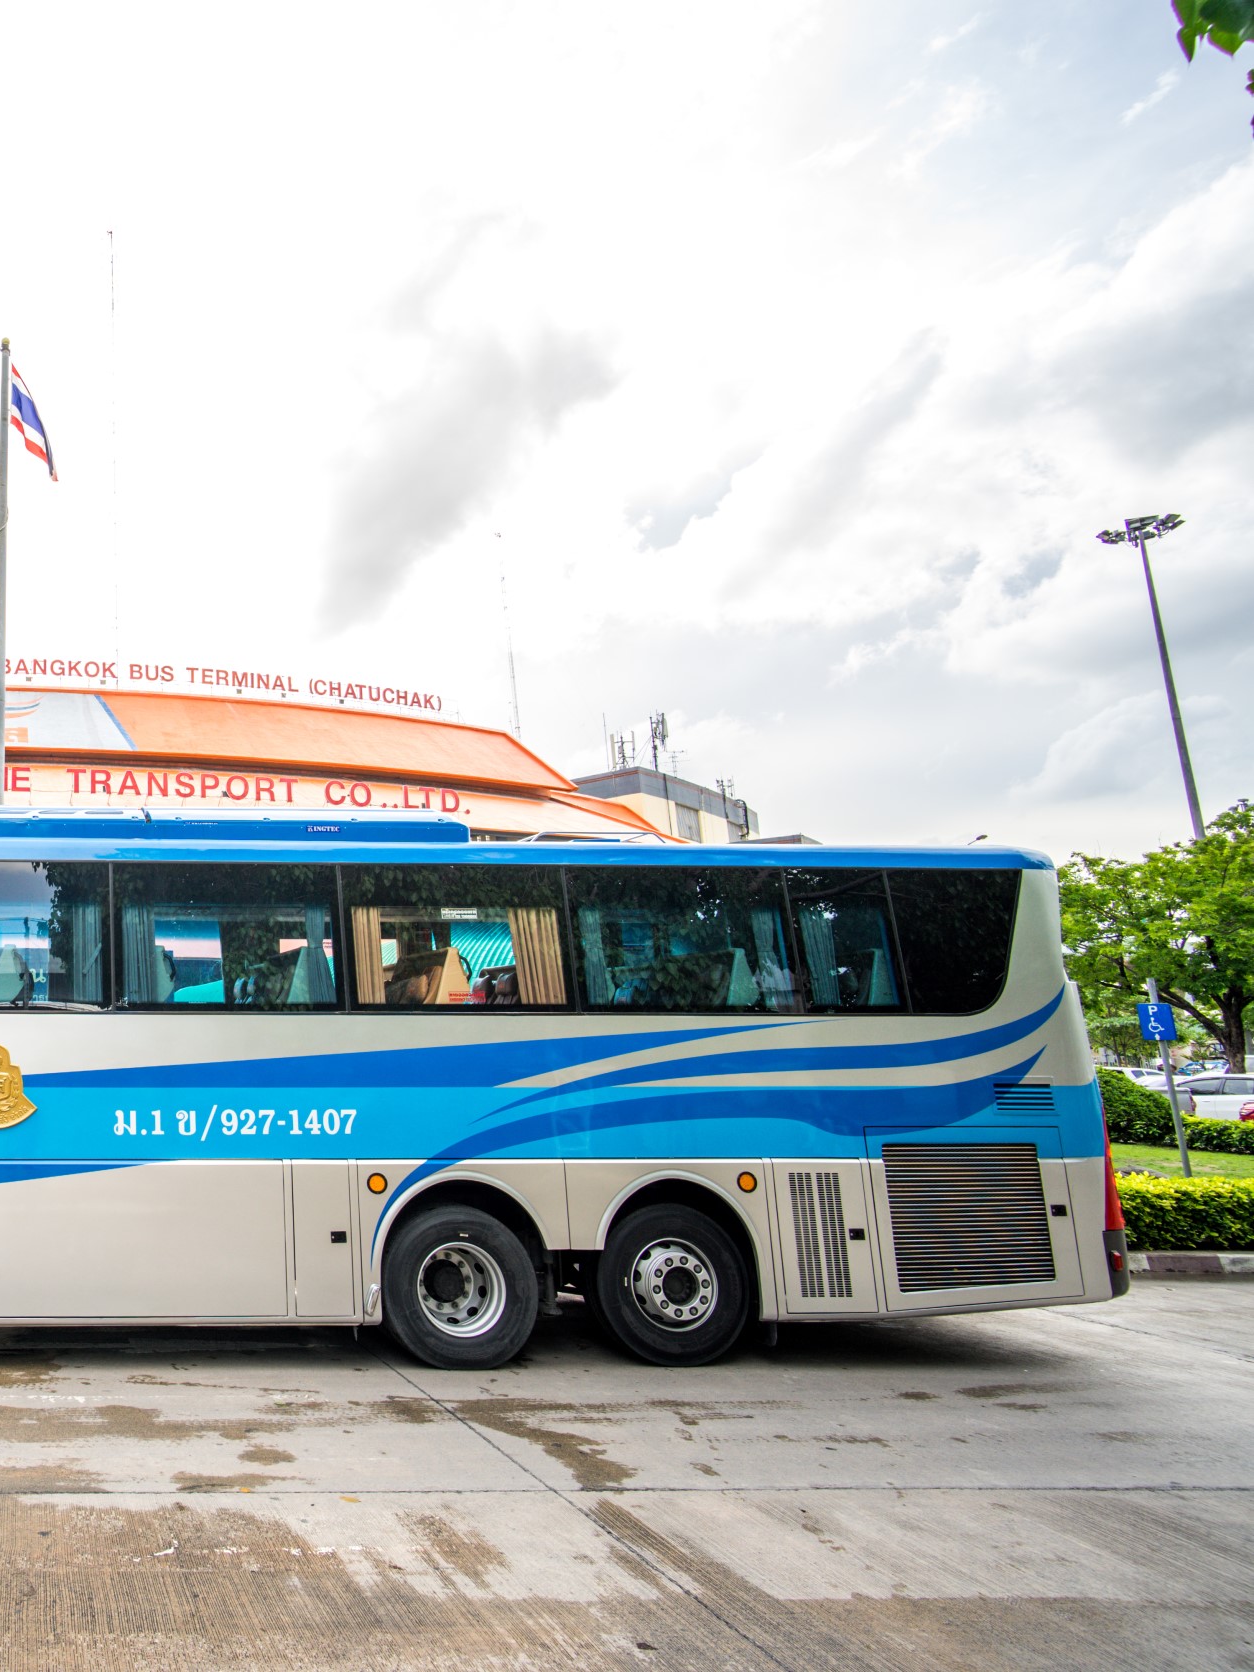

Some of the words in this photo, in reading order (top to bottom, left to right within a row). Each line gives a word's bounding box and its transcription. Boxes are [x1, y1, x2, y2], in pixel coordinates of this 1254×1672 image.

[129, 663, 175, 682] BUS
[185, 667, 299, 693] TERMINAL
[309, 678, 443, 712] (CHATUCHAK)
[66, 768, 299, 803] TRANSPORT
[1148, 1005, 1158, 1016] P
[113, 1108, 166, 1137] ม.1
